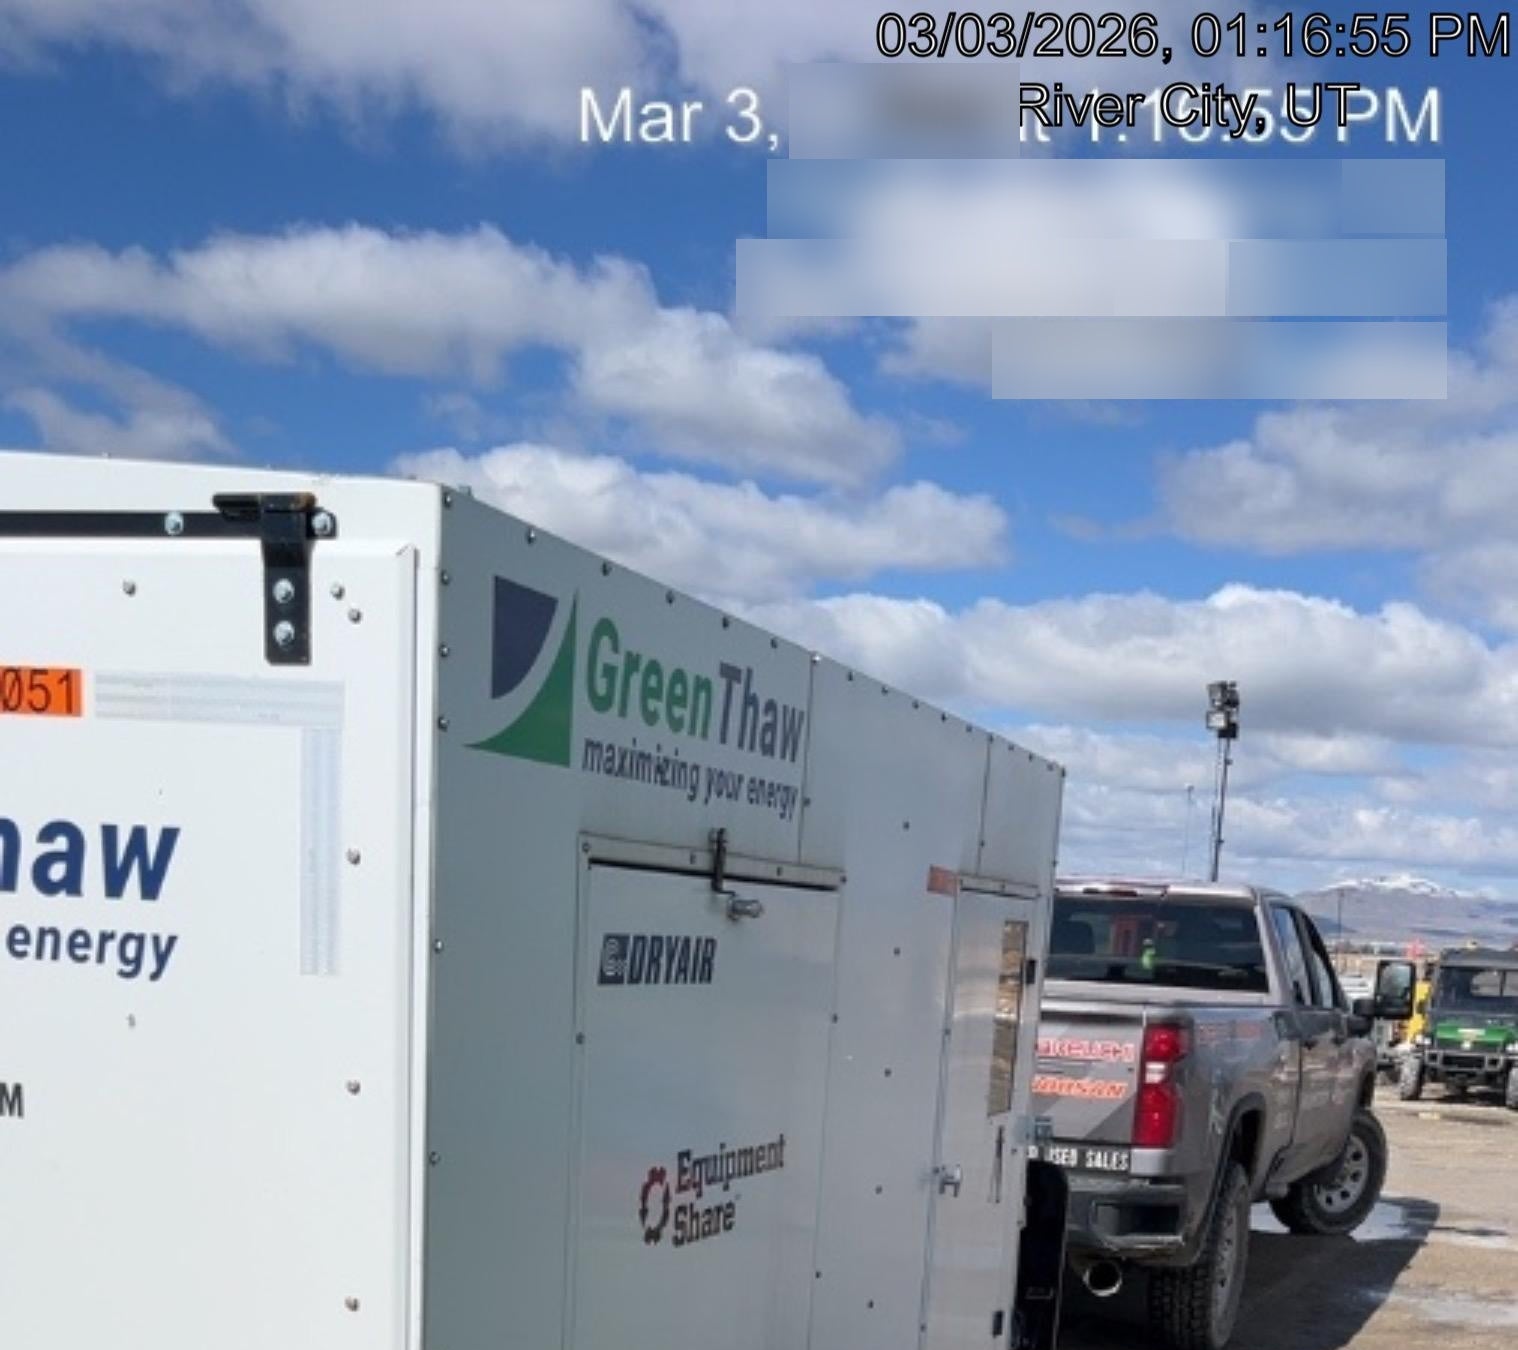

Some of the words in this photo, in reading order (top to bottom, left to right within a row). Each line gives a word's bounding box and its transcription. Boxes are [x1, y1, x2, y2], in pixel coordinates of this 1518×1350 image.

[586, 617, 805, 763] GreenThaw
[582, 736, 701, 802] maximizing
[703, 766, 744, 806] your
[746, 776, 799, 823] energy
[6, 924, 178, 982] energy
[626, 935, 718, 985] DRYAIR
[675, 1133, 786, 1200] Equipment
[1085, 1149, 1129, 1172] SALES
[671, 1198, 737, 1249] Share
